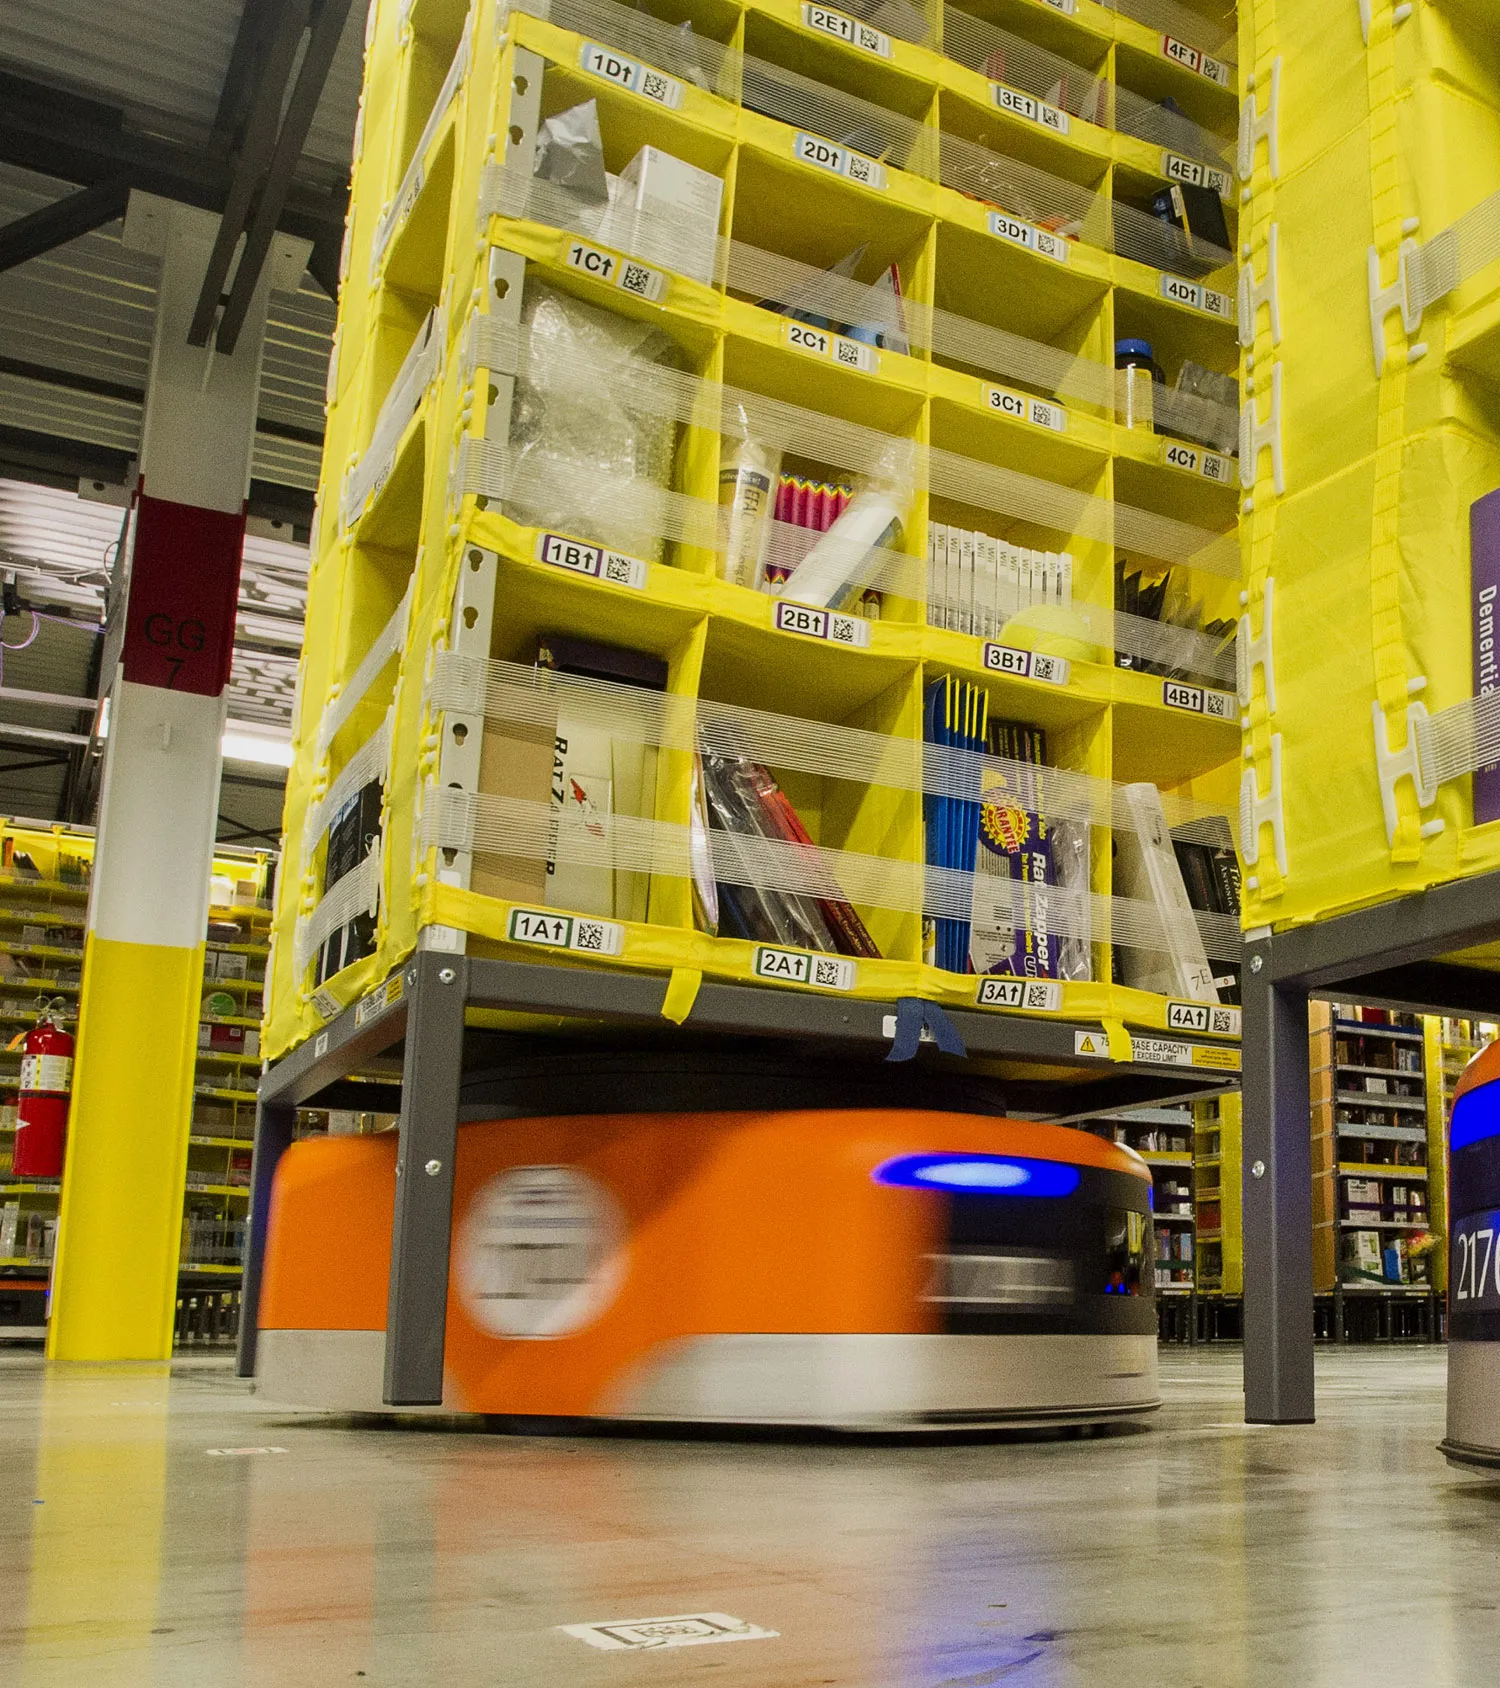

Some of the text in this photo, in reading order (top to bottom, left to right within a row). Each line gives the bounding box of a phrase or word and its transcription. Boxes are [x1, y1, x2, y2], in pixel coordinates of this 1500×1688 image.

[815, 11, 838, 33] 2E
[1169, 41, 1187, 62] 4F
[594, 54, 622, 79] 1D
[1002, 92, 1024, 113] 3E
[805, 141, 828, 164] 2D
[1171, 161, 1190, 180] 4E
[998, 219, 1019, 239] 3D
[572, 247, 600, 272] 1C
[1169, 282, 1188, 302] 4D
[791, 327, 816, 349] 2C
[991, 391, 1014, 413] 3C
[1168, 446, 1188, 467] 4C
[552, 543, 580, 567] 1B
[784, 610, 811, 632] 2B
[144, 613, 207, 652] GG
[1479, 584, 1499, 700] Dementia
[991, 650, 1014, 670] 3B
[164, 656, 185, 689] 7
[1169, 687, 1190, 706] 4B
[553, 736, 568, 783] RAT
[1032, 852, 1047, 888] Rat
[521, 916, 551, 940] 1A
[764, 953, 791, 976] 2A
[984, 983, 1009, 1004] 3A
[1172, 1006, 1195, 1027] 4A
[1132, 1039, 1151, 1052] BASE
[1152, 1042, 1189, 1055] CAPACITY
[1137, 1052, 1161, 1062] EXCEED
[1162, 1055, 1178, 1063] LIMIT
